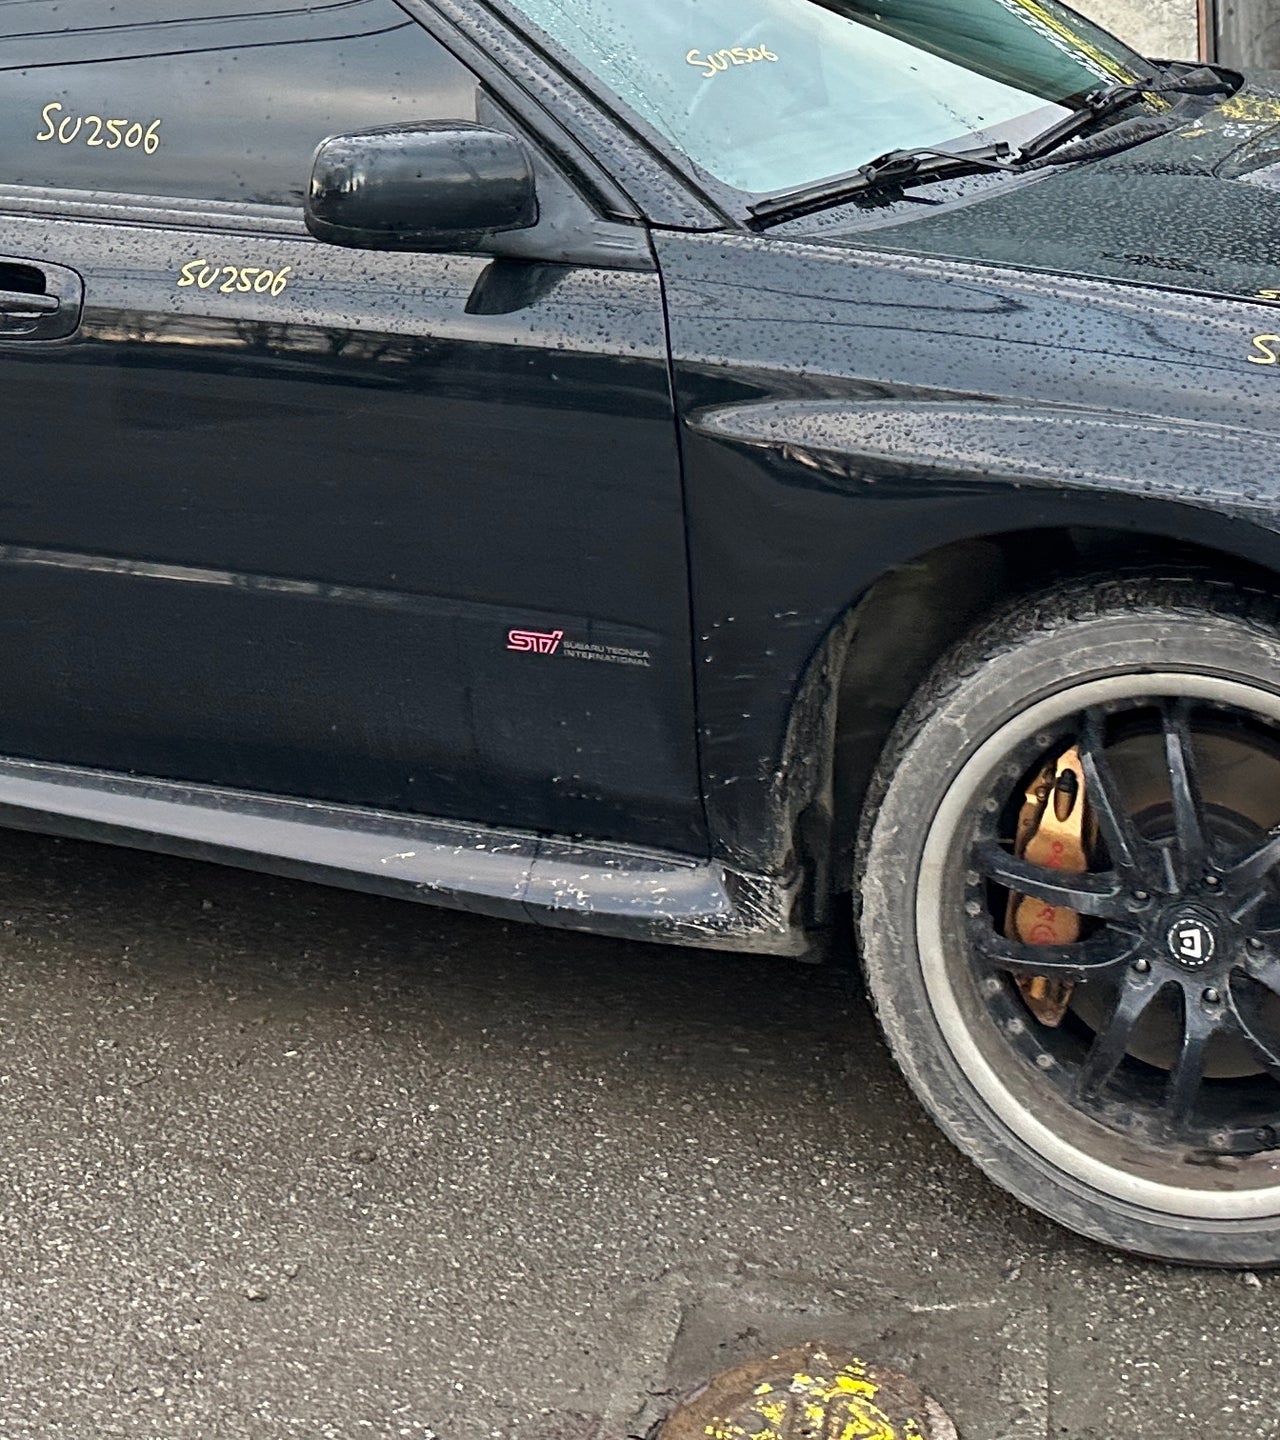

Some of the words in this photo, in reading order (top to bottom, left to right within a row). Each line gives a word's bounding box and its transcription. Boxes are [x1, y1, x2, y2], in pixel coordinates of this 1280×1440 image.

[686, 44, 779, 78] SU2506
[35, 102, 161, 154] SU2506
[177, 259, 292, 297] SU2506
[563, 641, 606, 653] SUBARU
[563, 650, 652, 667] INTERNATIONAL
